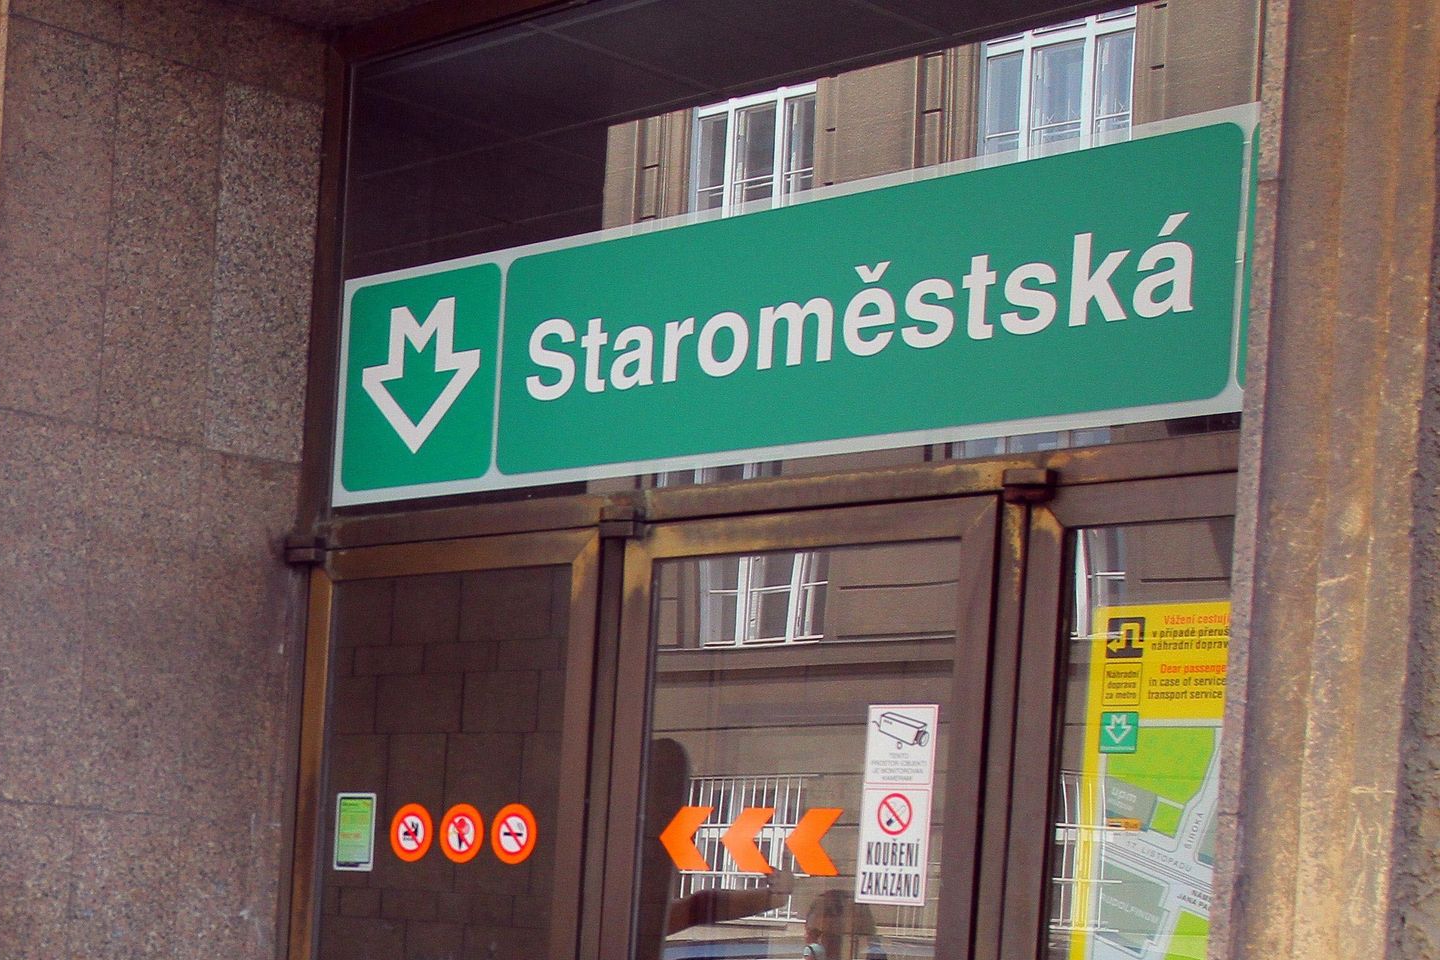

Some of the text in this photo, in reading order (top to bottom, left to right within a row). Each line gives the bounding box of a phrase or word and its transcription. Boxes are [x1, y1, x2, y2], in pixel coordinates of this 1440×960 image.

[525, 211, 1195, 401] Staroměstská
[1160, 664, 1181, 673] Dear
[1148, 677, 1157, 687] in
[1160, 678, 1180, 687] case
[1183, 677, 1192, 687] of
[1148, 690, 1223, 701] transport service
[866, 838, 920, 867] KOUŘENÍ
[861, 868, 920, 898] ZAKÁZÁNO
